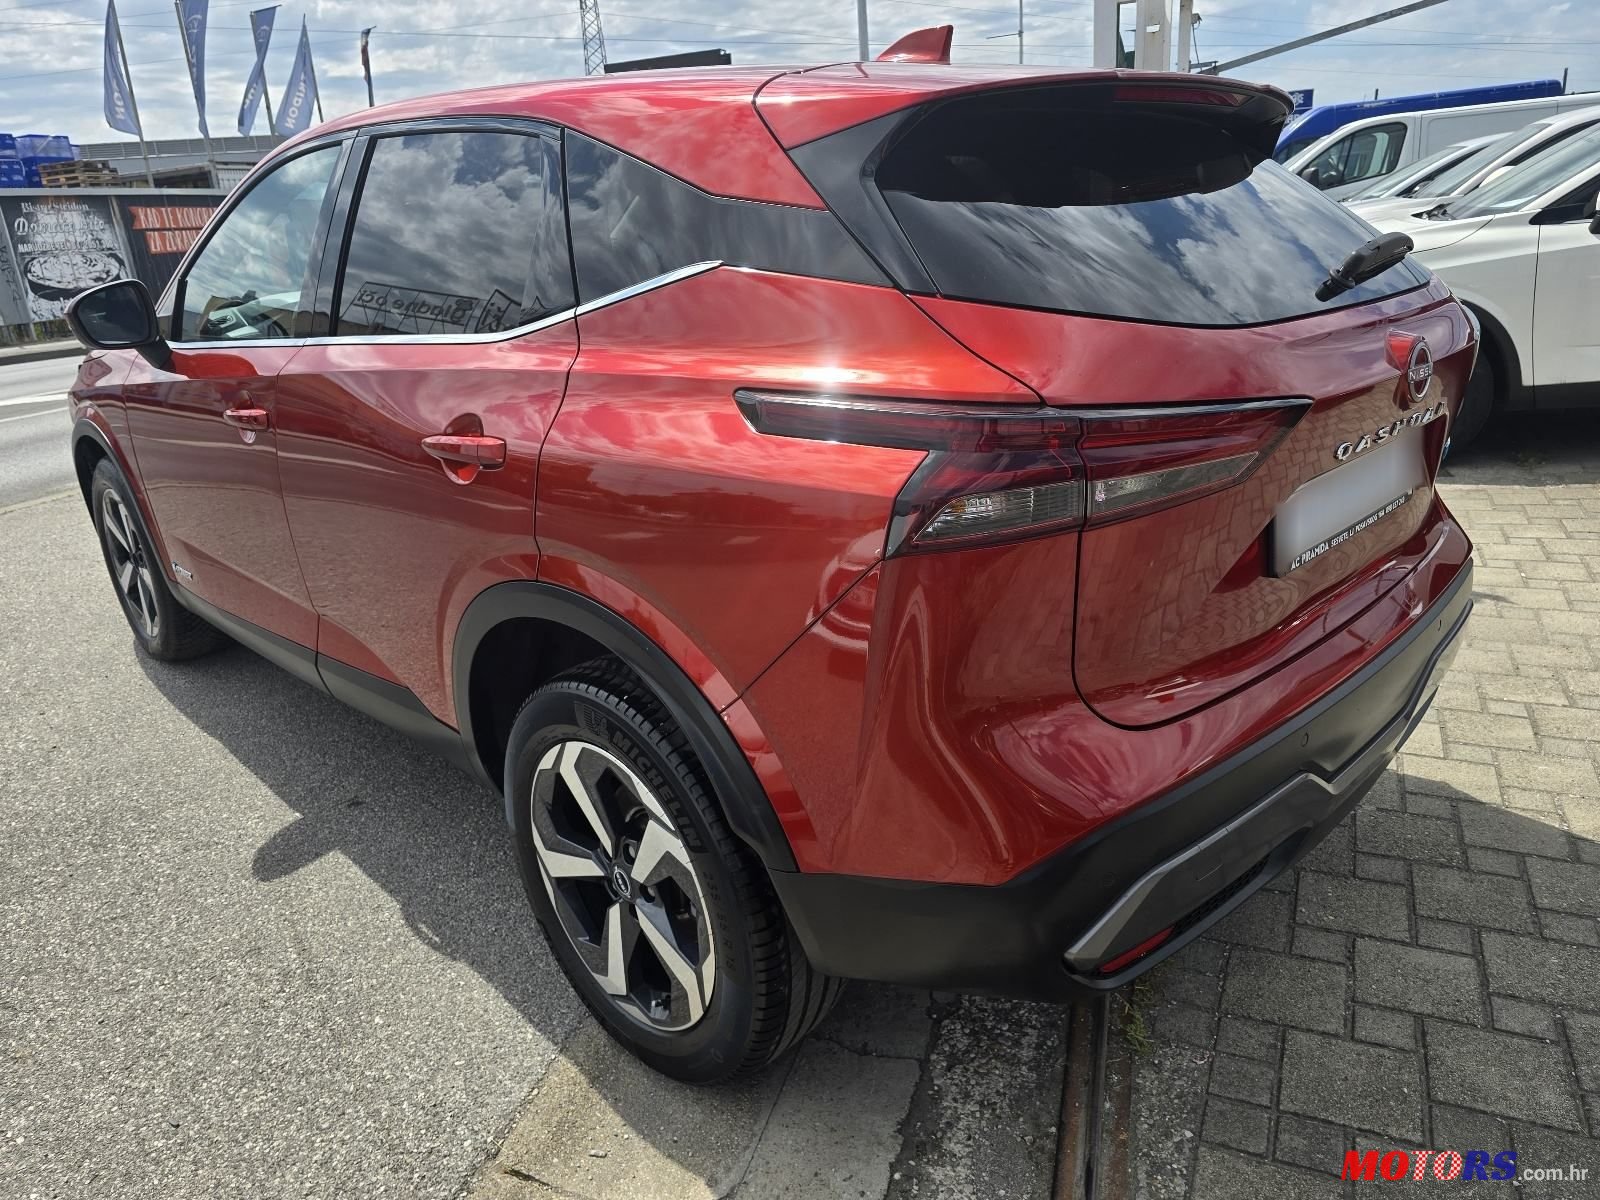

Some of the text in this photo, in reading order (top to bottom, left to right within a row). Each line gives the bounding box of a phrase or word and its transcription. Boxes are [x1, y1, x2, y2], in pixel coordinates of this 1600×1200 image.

[138, 207, 160, 228] KAD
[161, 207, 176, 228] TE
[145, 230, 163, 252] ZA
[1291, 556, 1301, 571] AC
[1301, 542, 1329, 565] PIRAMIDA
[612, 730, 702, 847] MICHELIN
